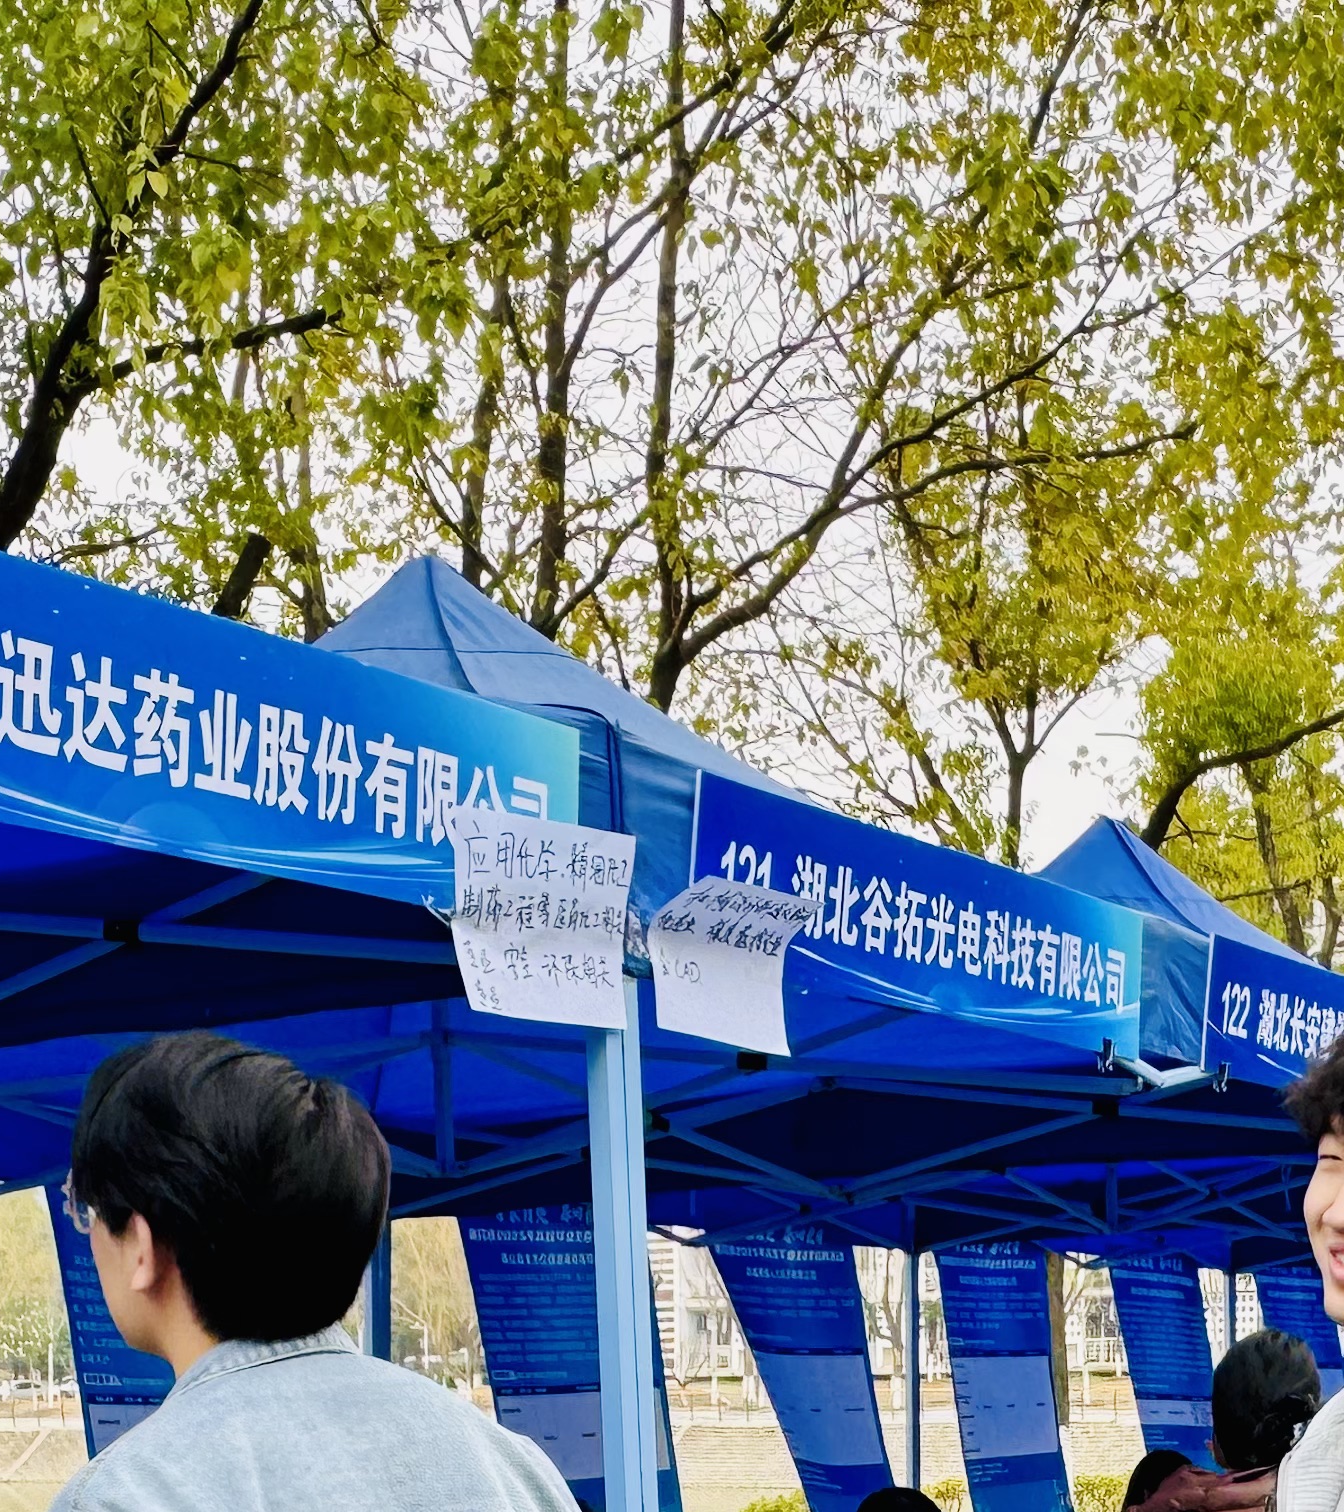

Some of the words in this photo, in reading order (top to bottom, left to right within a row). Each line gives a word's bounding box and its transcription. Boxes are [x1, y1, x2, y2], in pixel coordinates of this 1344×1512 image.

[791, 855, 1127, 1014] 湖北谷拓光电科技有限公司
[1222, 981, 1251, 1039] 122
